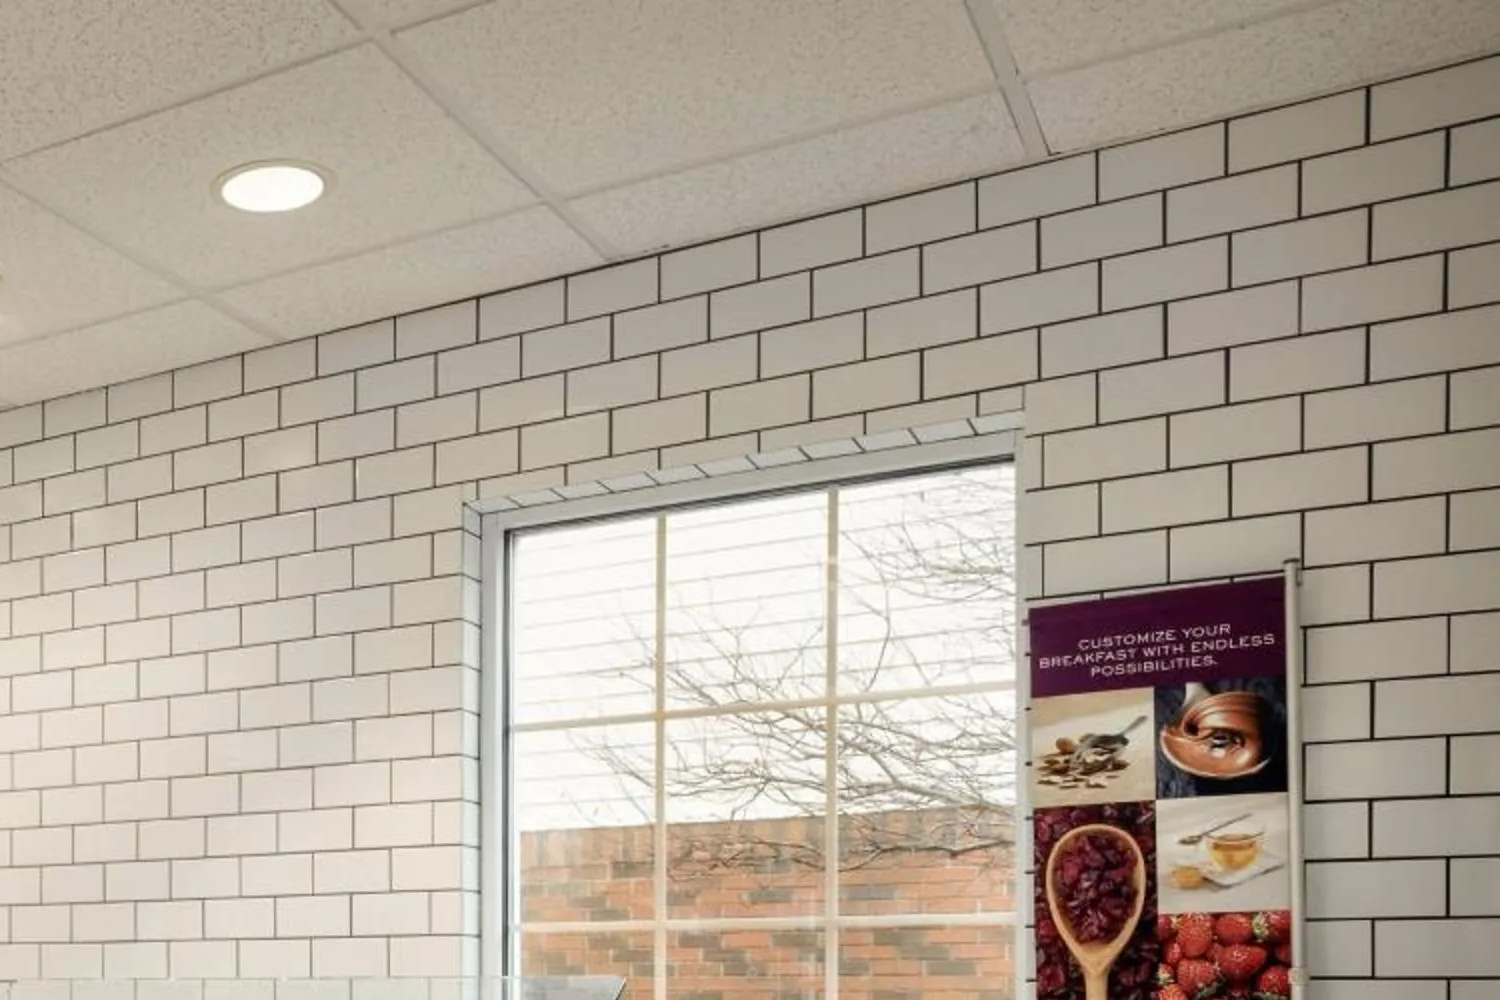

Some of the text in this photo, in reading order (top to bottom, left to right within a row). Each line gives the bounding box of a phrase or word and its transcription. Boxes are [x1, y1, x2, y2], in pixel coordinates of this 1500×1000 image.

[1039, 633, 1275, 669] BREAKFAST WITH ENDLESS
[1078, 623, 1231, 651] CUSTOMIZE YOUR
